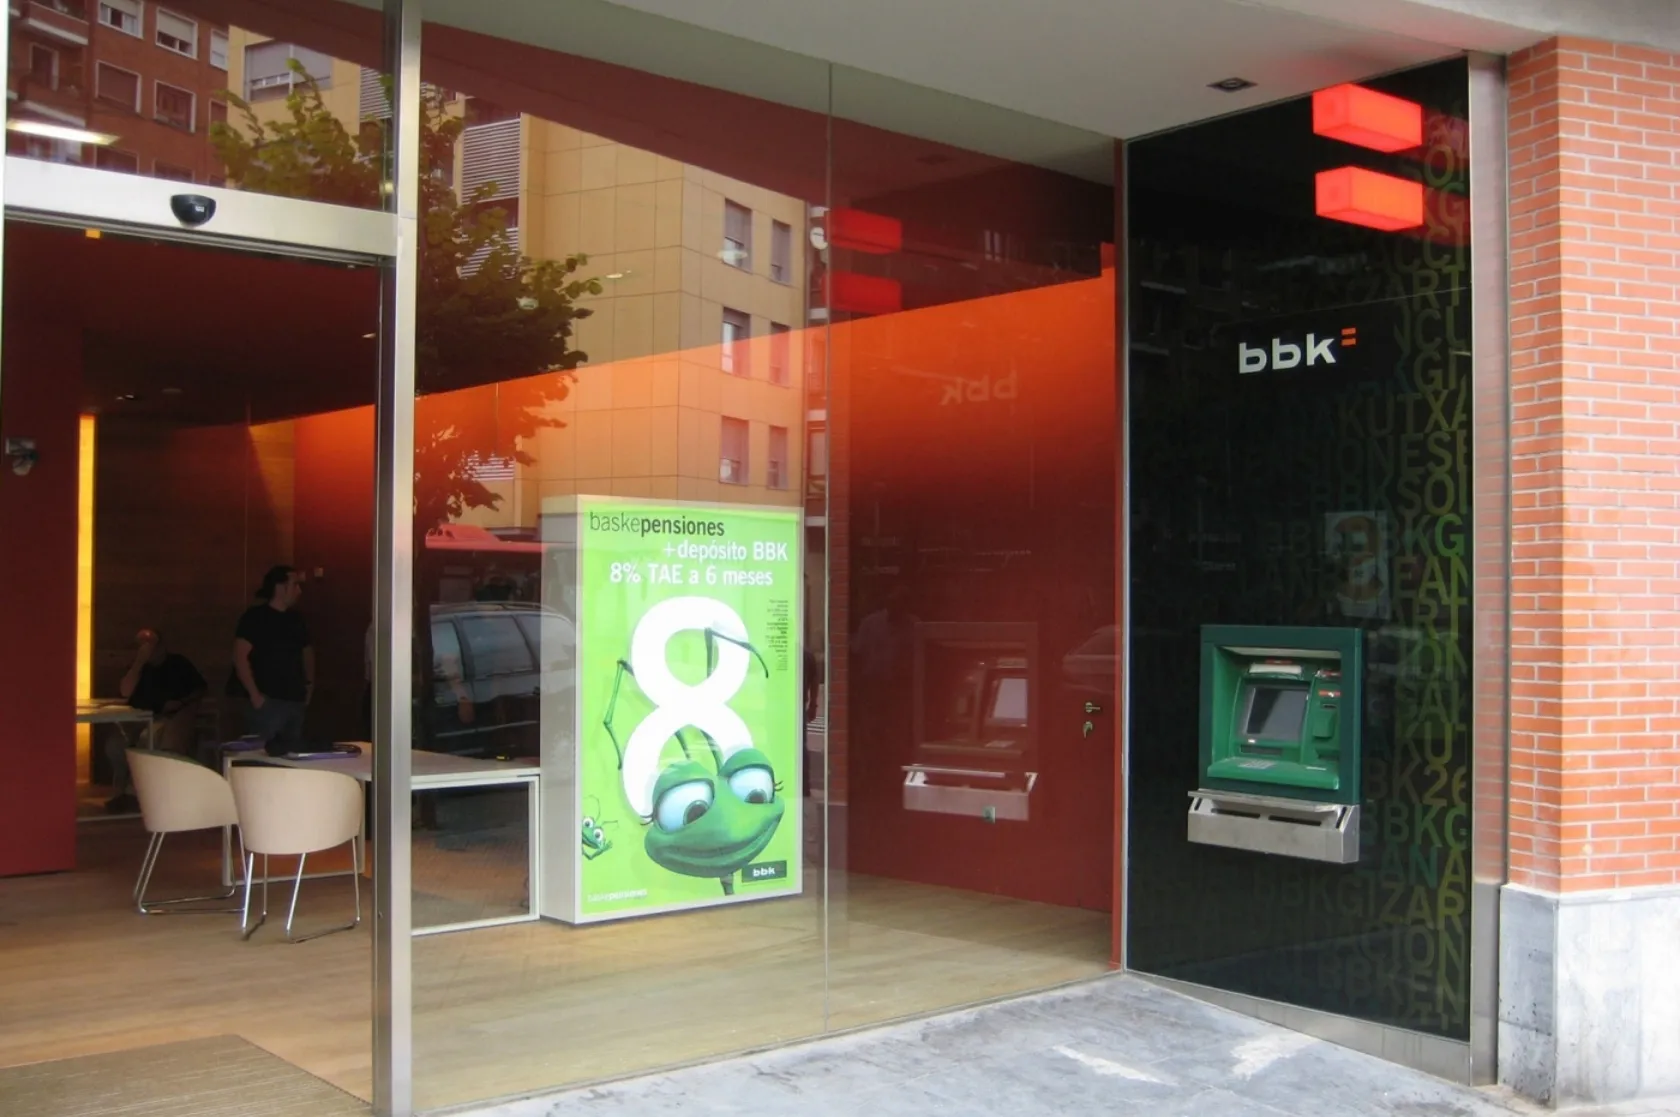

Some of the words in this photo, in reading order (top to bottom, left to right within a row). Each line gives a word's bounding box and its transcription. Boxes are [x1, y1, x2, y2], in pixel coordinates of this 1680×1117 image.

[1238, 332, 1337, 374] bbk
[589, 511, 725, 538] baskepensiones
[752, 540, 789, 562] BBK
[610, 562, 642, 584] 8%
[648, 563, 684, 585] TAE
[688, 569, 700, 585] a
[705, 565, 717, 585] 6
[722, 569, 773, 586] meses
[752, 866, 776, 878] bbk
